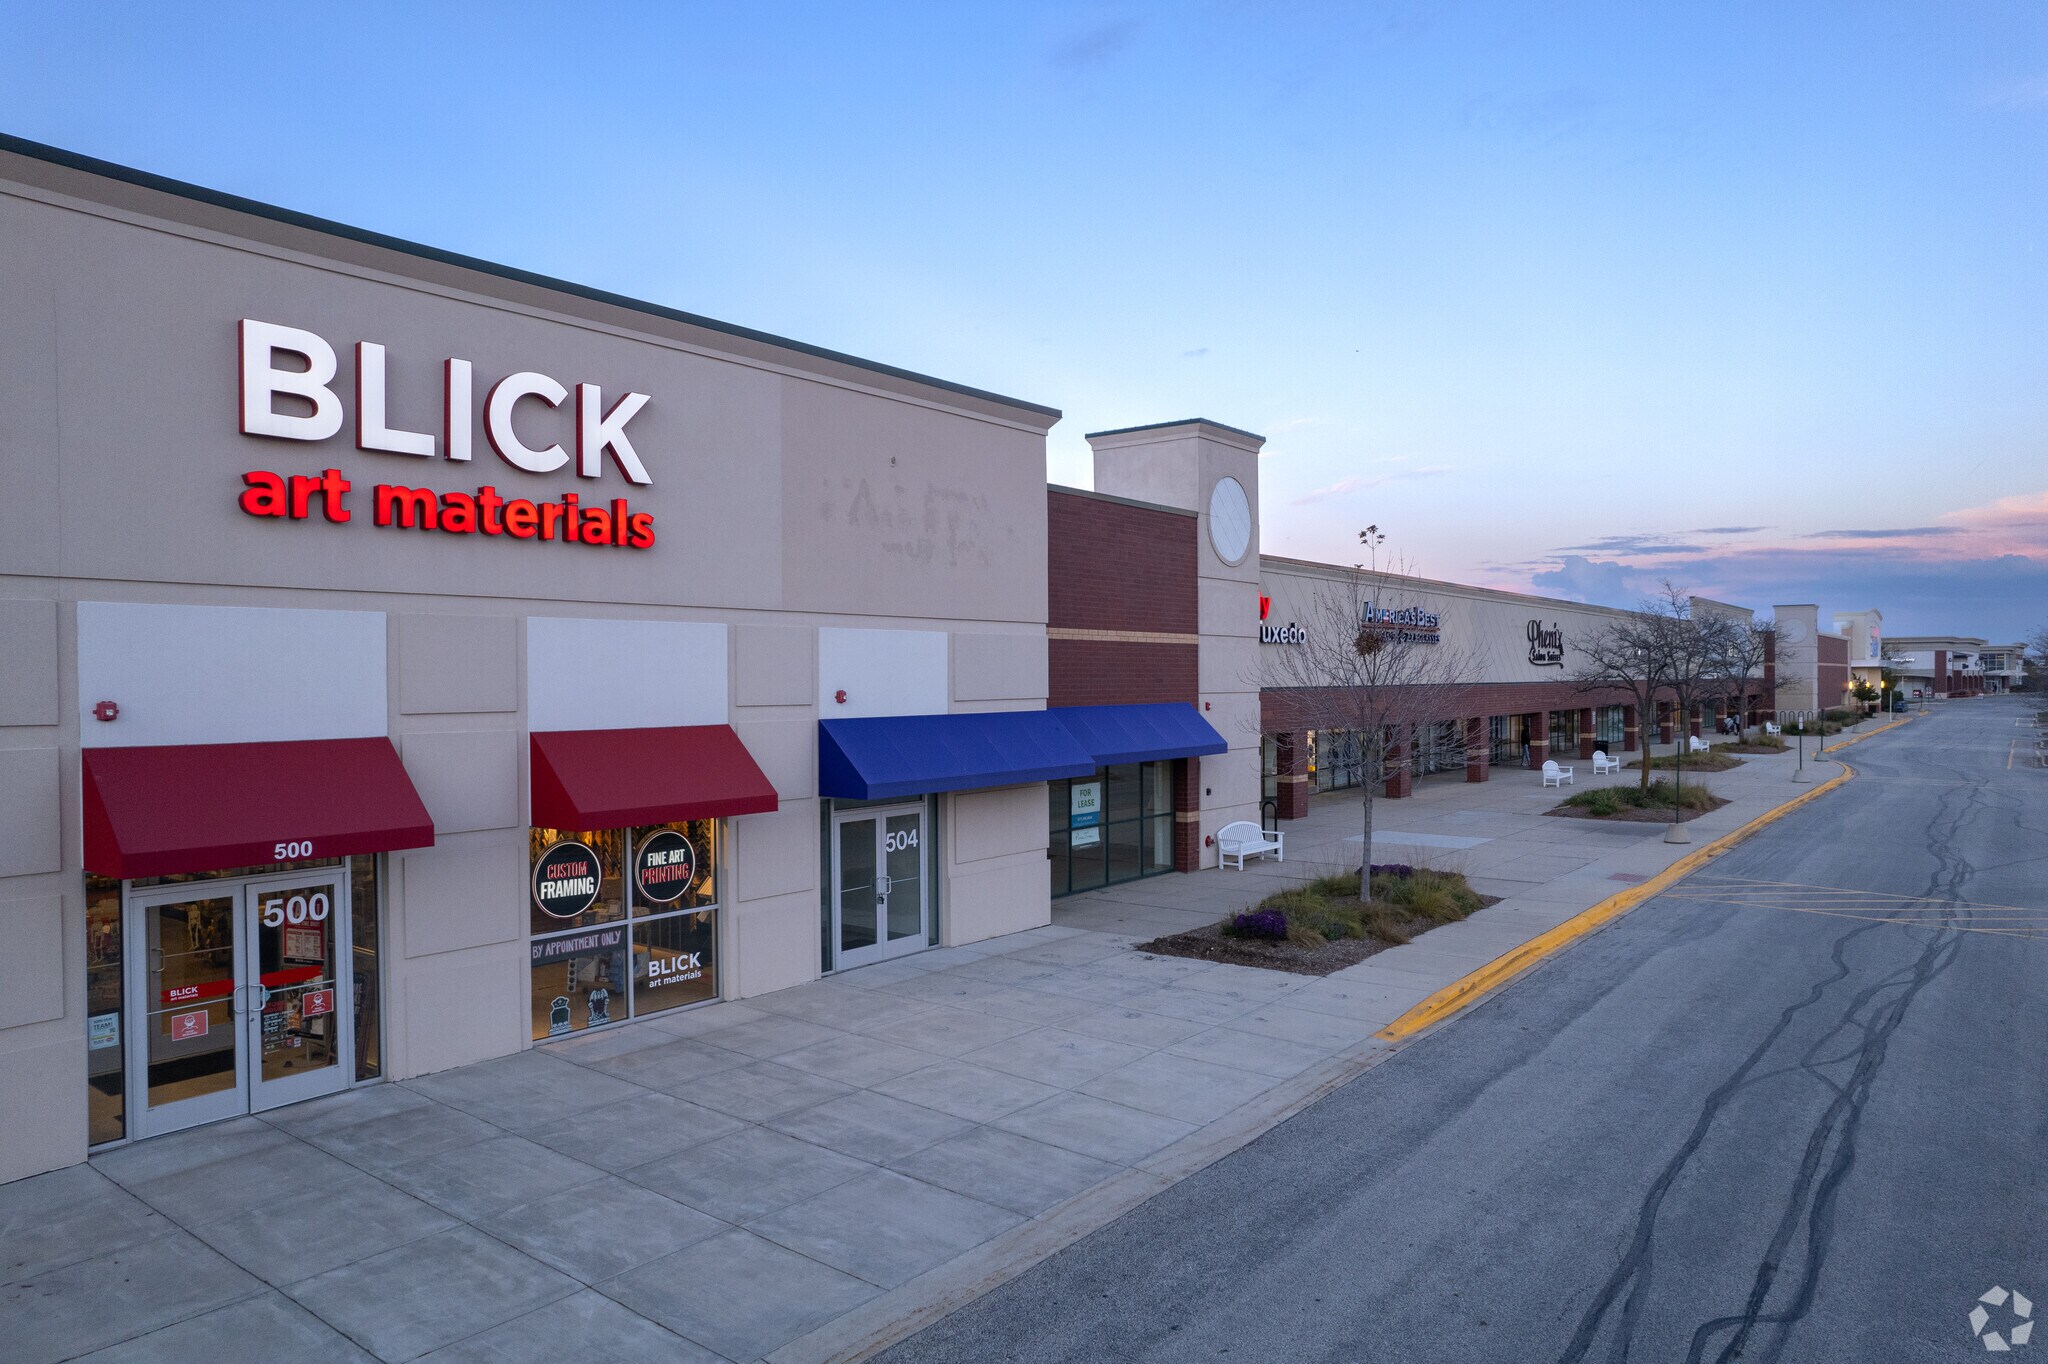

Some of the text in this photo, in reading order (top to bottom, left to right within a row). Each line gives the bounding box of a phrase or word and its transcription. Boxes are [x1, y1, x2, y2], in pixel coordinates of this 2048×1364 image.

[238, 318, 654, 485] BLICK
[239, 468, 656, 549] art materials
[1260, 621, 1306, 644] uxedo
[1527, 620, 1564, 655] Phenix
[1078, 799, 1095, 808] LEASE
[1080, 789, 1091, 797] FOR
[274, 841, 313, 859] 500
[886, 829, 918, 852] 504
[647, 849, 685, 867] FINE ART
[547, 861, 587, 880] CUSTOM
[641, 864, 690, 885] PRINTING
[540, 877, 595, 900] FRAMING
[263, 893, 329, 928] 500
[532, 931, 621, 959] BY APPOINTMENT ONLY
[648, 952, 701, 978] BLICK
[649, 970, 702, 988] art materials
[170, 986, 198, 997] BLICK
